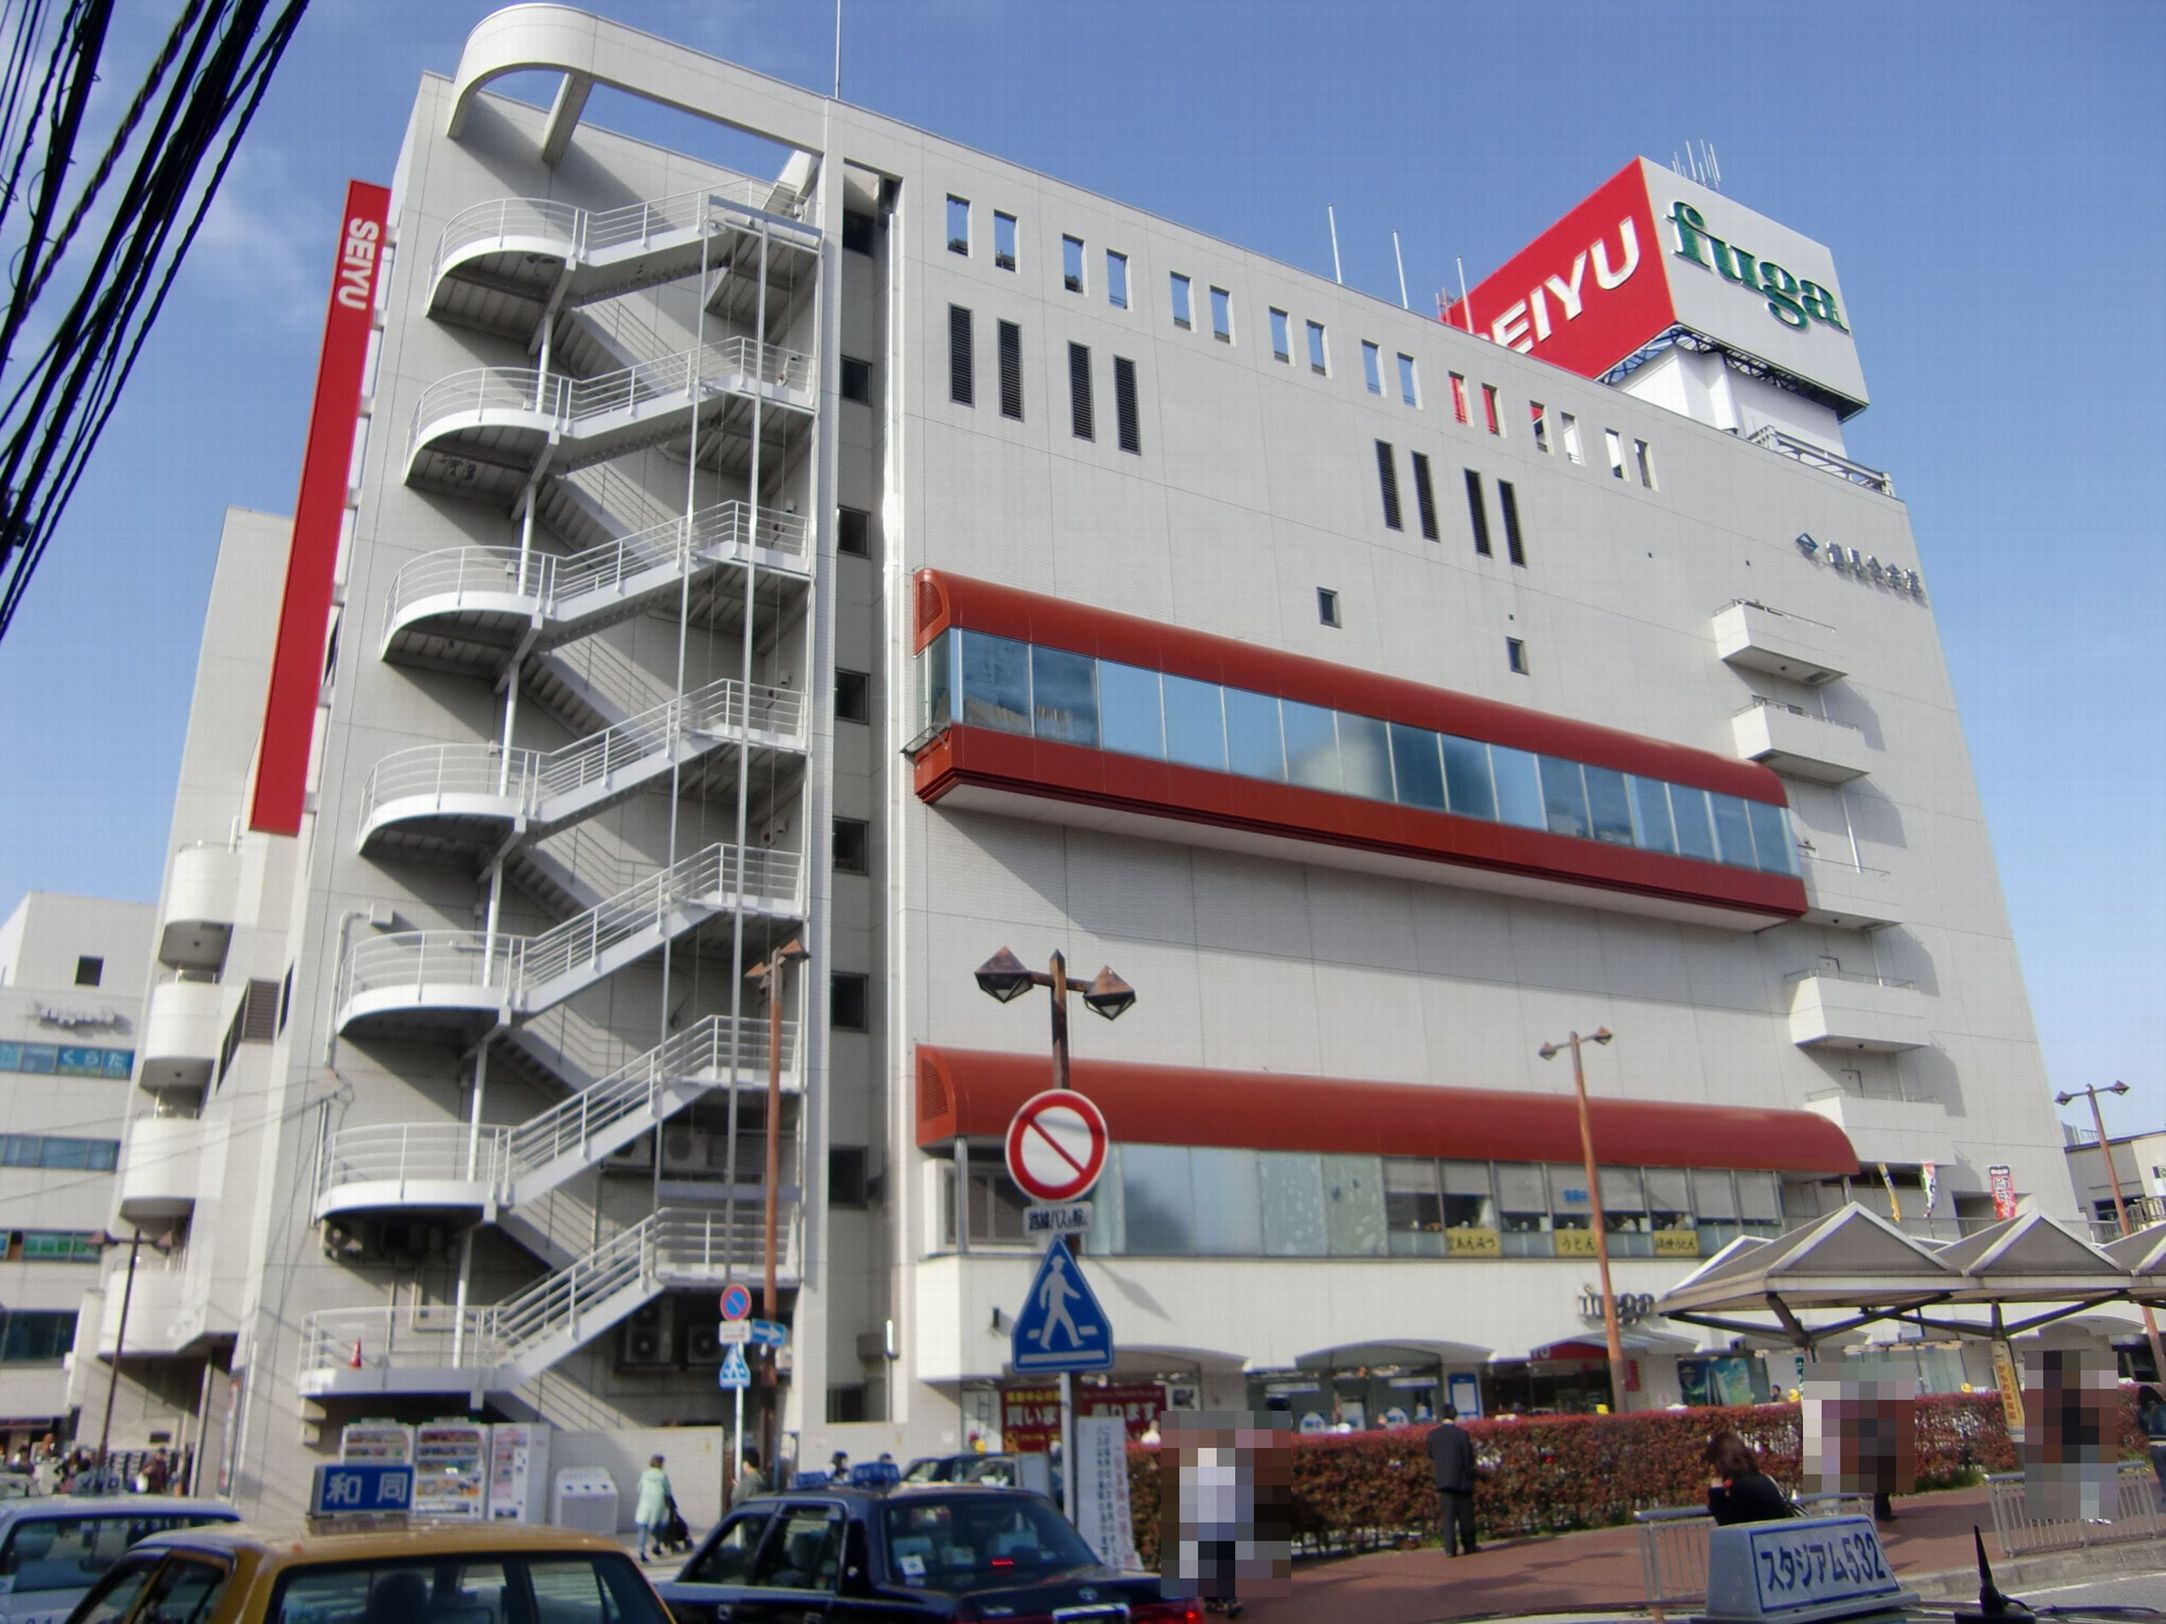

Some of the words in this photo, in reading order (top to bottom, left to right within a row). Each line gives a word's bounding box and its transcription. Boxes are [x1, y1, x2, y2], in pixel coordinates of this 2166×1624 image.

[338, 217, 379, 310] SEIYU
[1480, 216, 1641, 354] EIYU
[1663, 200, 1850, 331] fuga
[326, 1471, 408, 1504] 和同
[1760, 1532, 1886, 1592] スタジアム532
